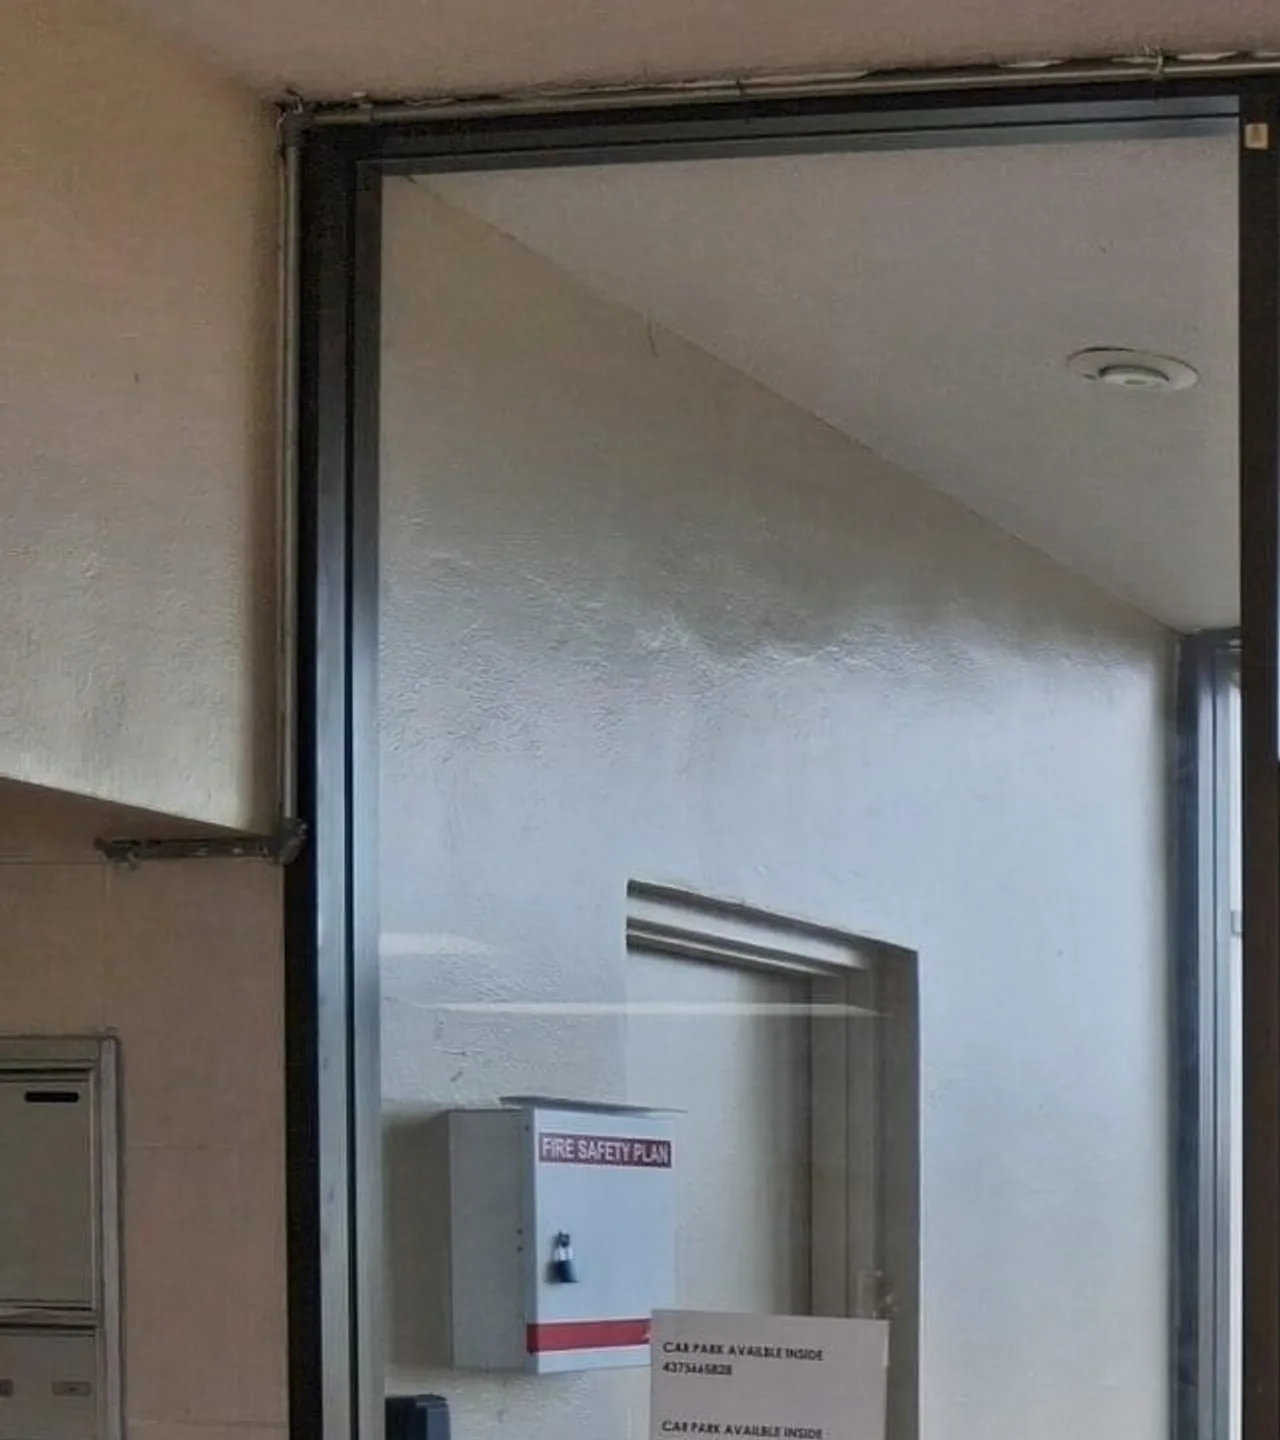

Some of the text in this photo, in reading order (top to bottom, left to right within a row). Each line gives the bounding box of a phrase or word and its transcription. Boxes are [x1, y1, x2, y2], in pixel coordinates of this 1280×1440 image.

[542, 1137, 669, 1163] FIRE SAFETY PLAN
[662, 1342, 823, 1361] CAR PARK AVAILBLE INSIDE
[662, 1421, 823, 1440] CAR PARK AVAILBLE INSIDE
